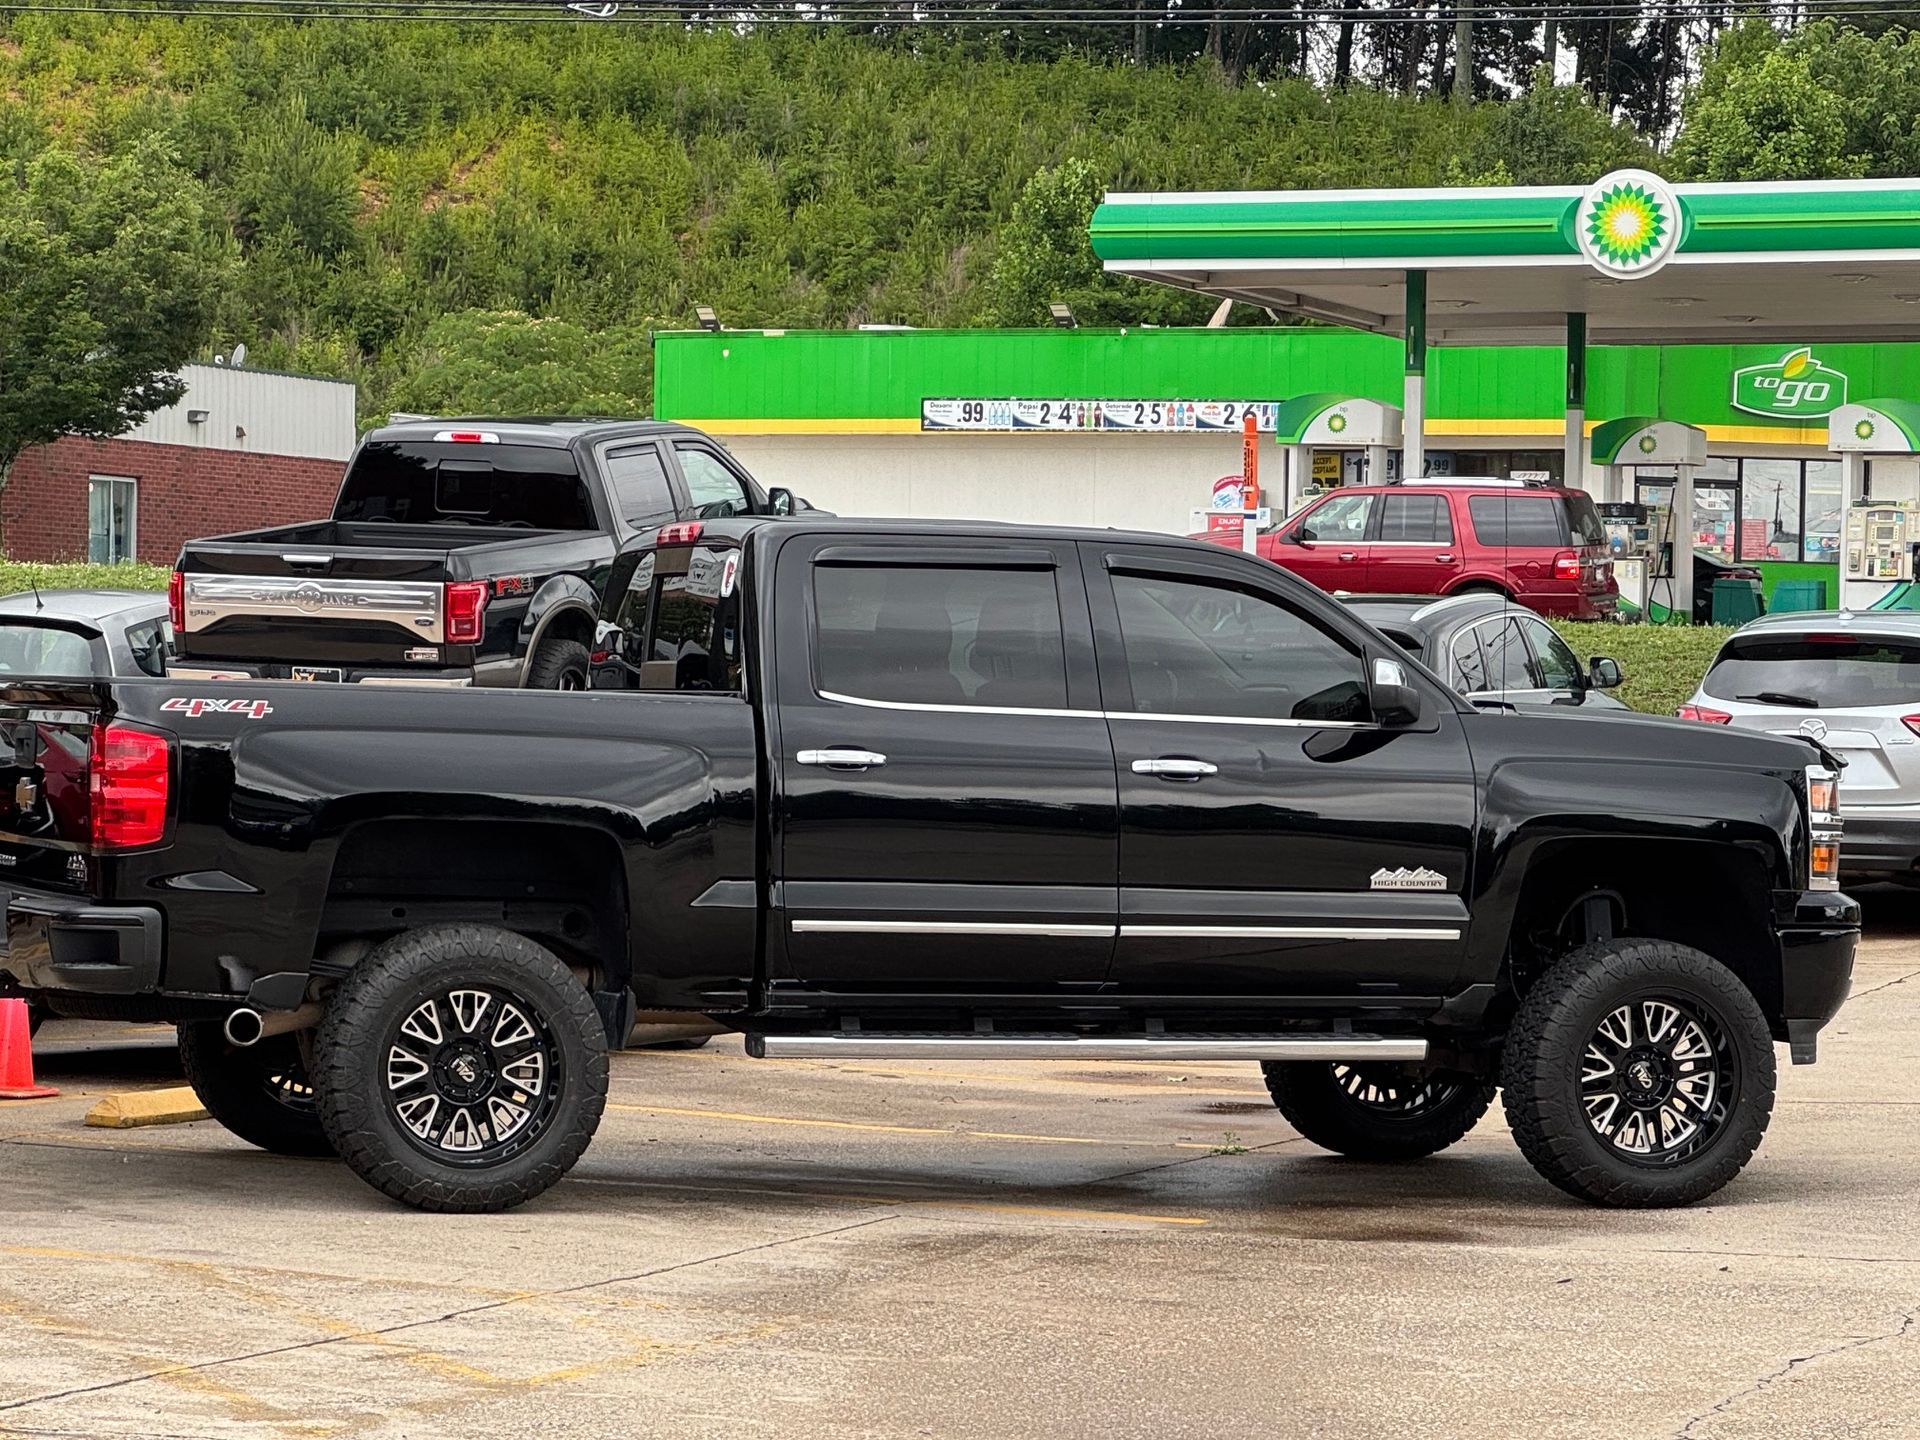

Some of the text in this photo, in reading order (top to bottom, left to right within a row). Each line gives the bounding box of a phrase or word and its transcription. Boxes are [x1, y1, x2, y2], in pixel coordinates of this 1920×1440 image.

[1754, 376, 1830, 407] to go
[1018, 402, 1038, 411] Pepsi
[1040, 402, 1050, 424] 2
[1058, 402, 1072, 424] 4
[1134, 403, 1161, 424] 2 5
[1223, 404, 1235, 425] 2
